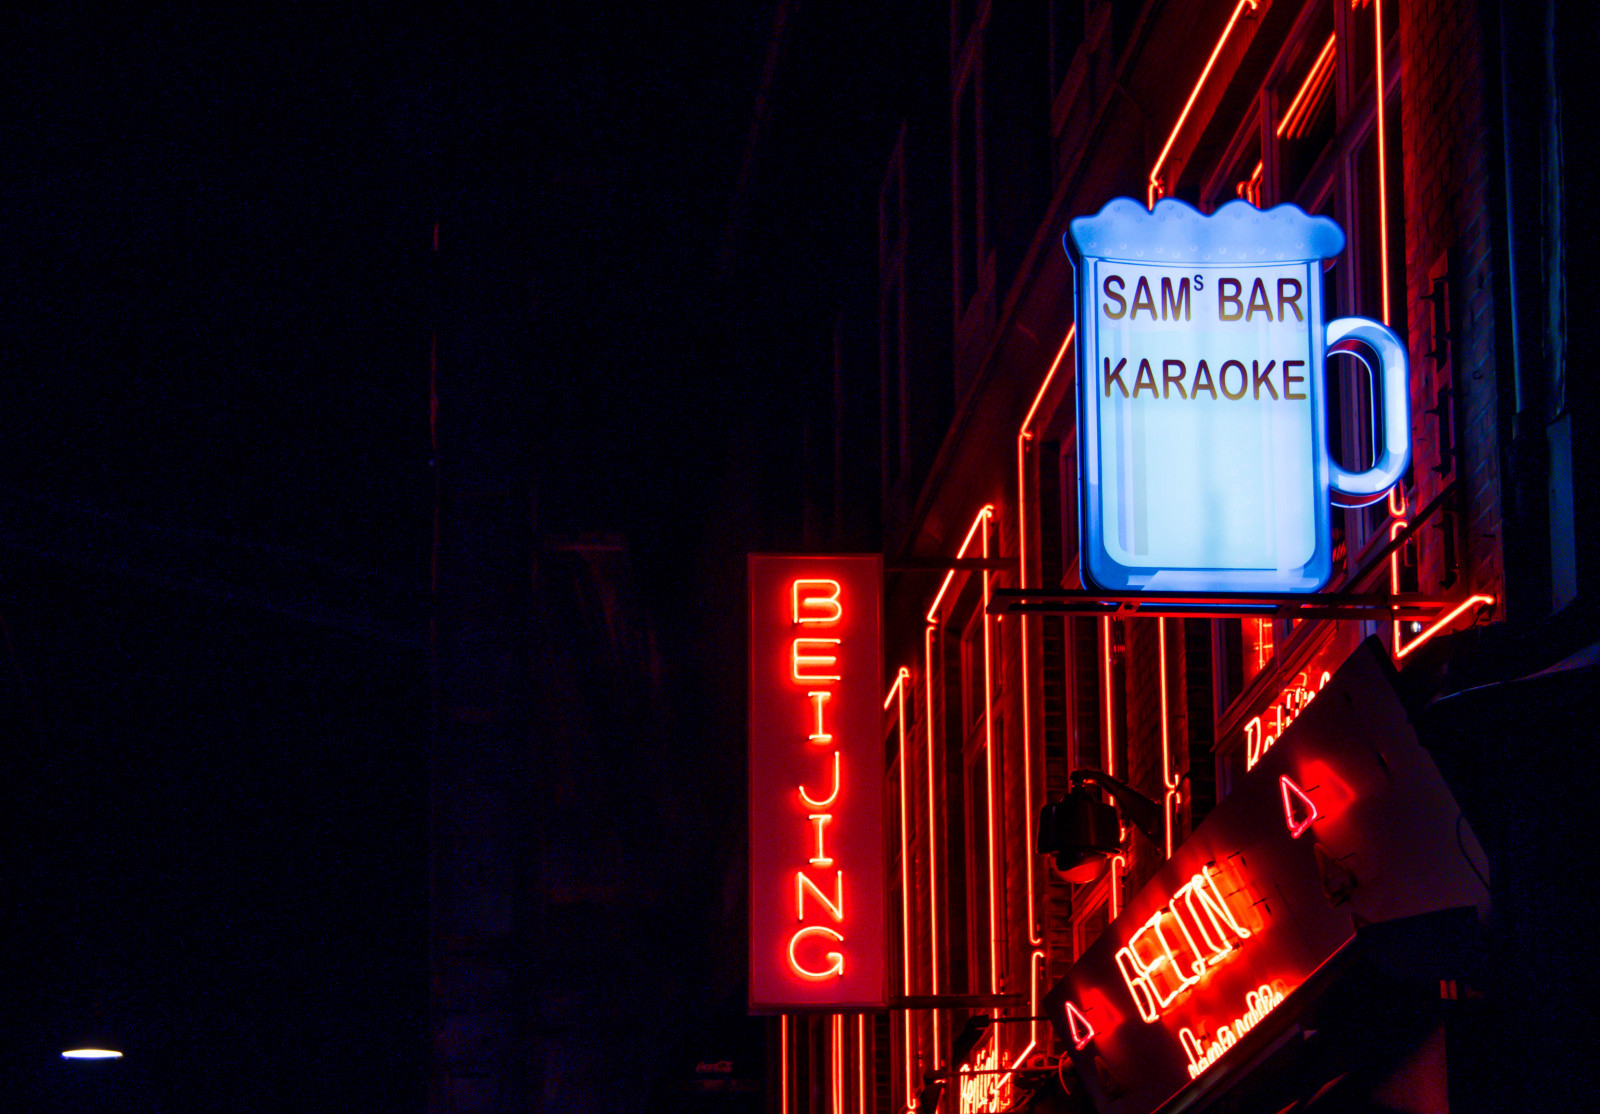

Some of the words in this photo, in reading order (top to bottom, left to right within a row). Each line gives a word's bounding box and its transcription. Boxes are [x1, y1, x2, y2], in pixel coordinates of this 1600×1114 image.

[1218, 277, 1304, 322] BAR
[1103, 356, 1307, 401] KARAOKE
[789, 578, 845, 978] BEIJING
